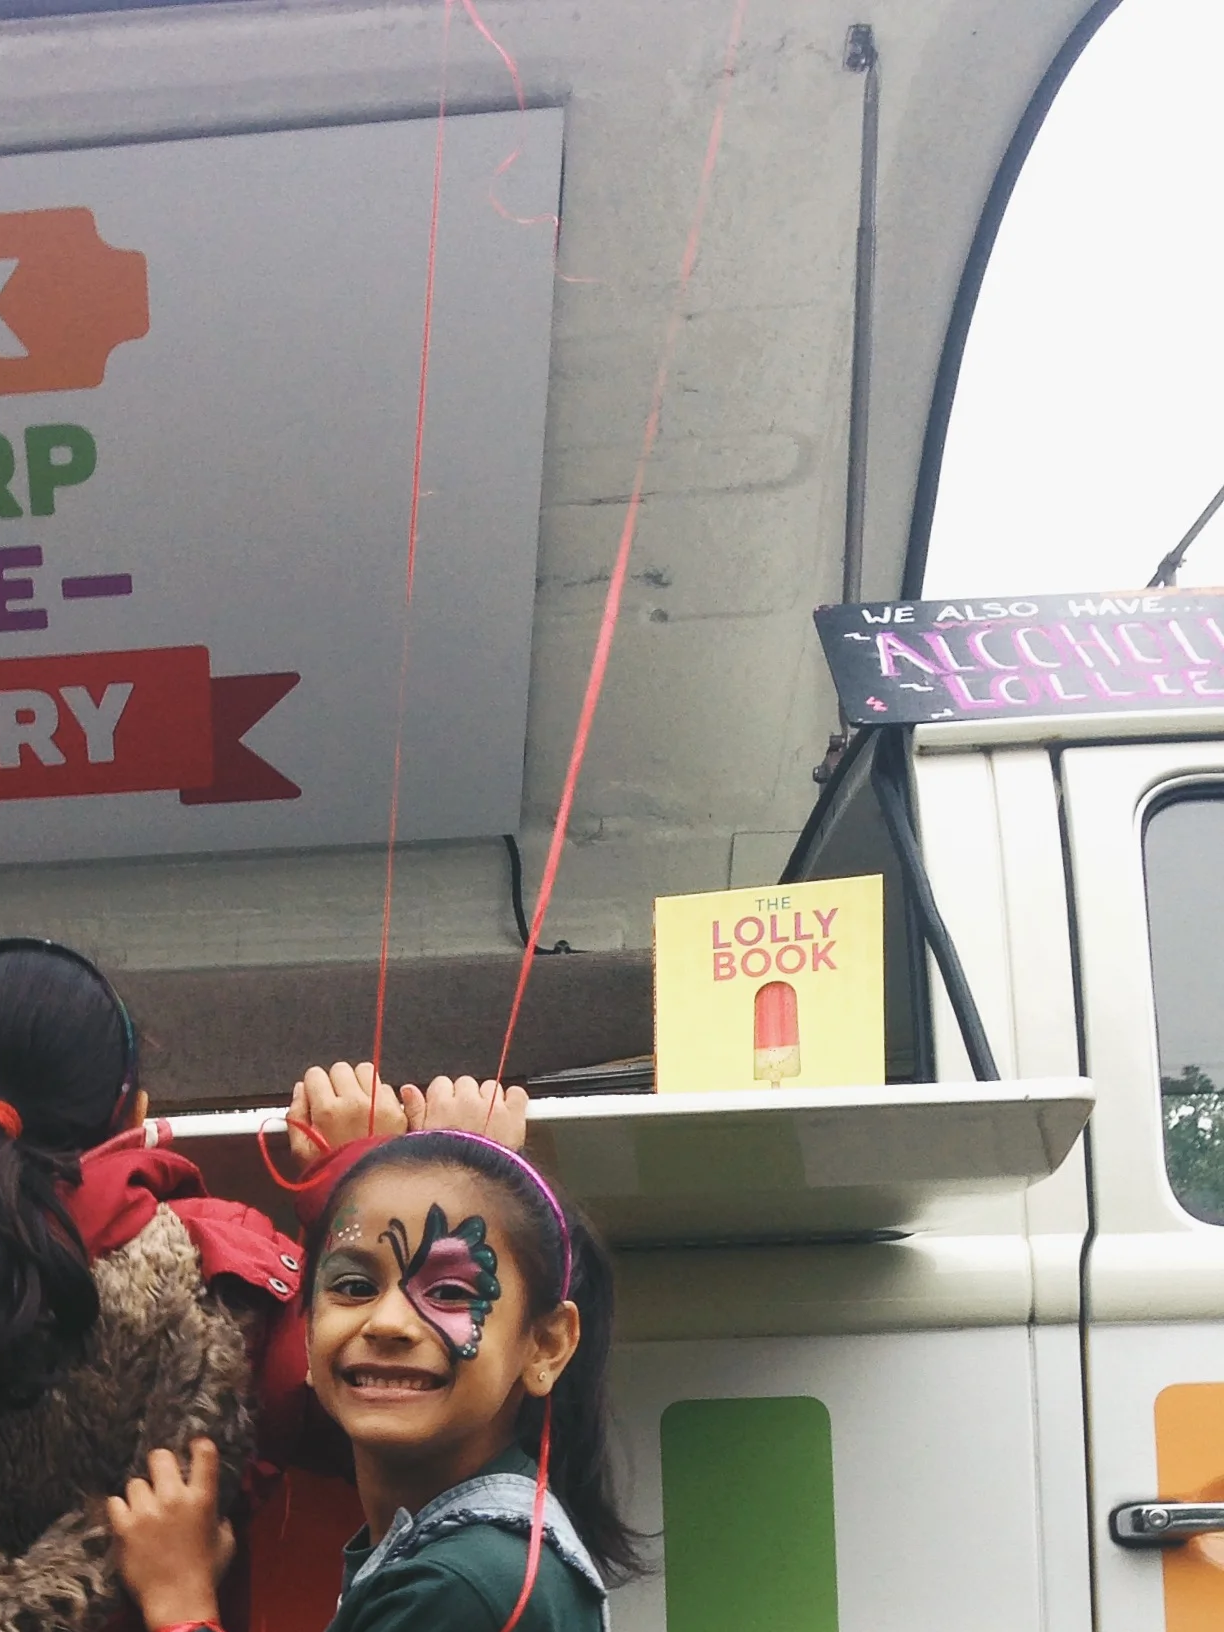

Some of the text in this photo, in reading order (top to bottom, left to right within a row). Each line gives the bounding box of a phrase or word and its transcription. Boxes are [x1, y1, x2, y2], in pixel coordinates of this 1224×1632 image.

[861, 606, 915, 625] WE
[935, 601, 1040, 623] ALSO
[755, 896, 792, 912] THE
[712, 907, 839, 950] LOLLY
[713, 940, 838, 982] BOOK
